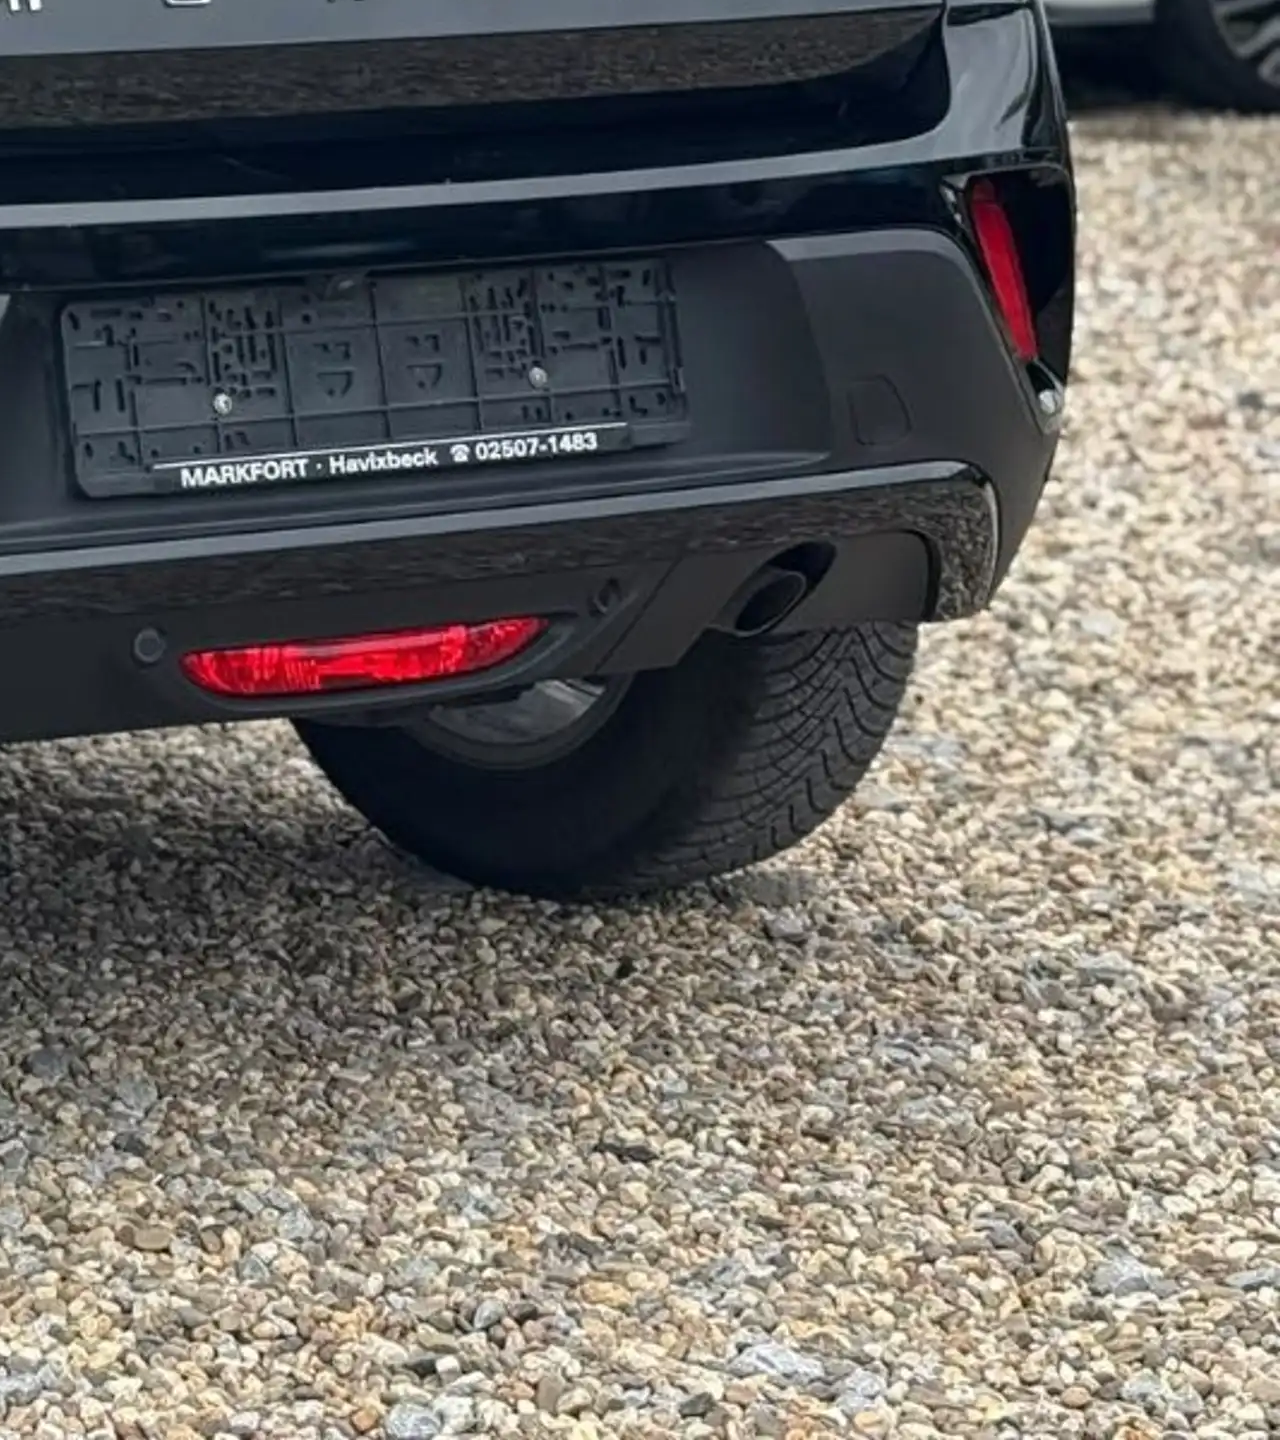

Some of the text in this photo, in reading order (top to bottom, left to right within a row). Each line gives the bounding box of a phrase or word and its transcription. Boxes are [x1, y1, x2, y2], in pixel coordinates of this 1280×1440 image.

[180, 431, 598, 488] MARKFORT Havixbeck 02507-1483
